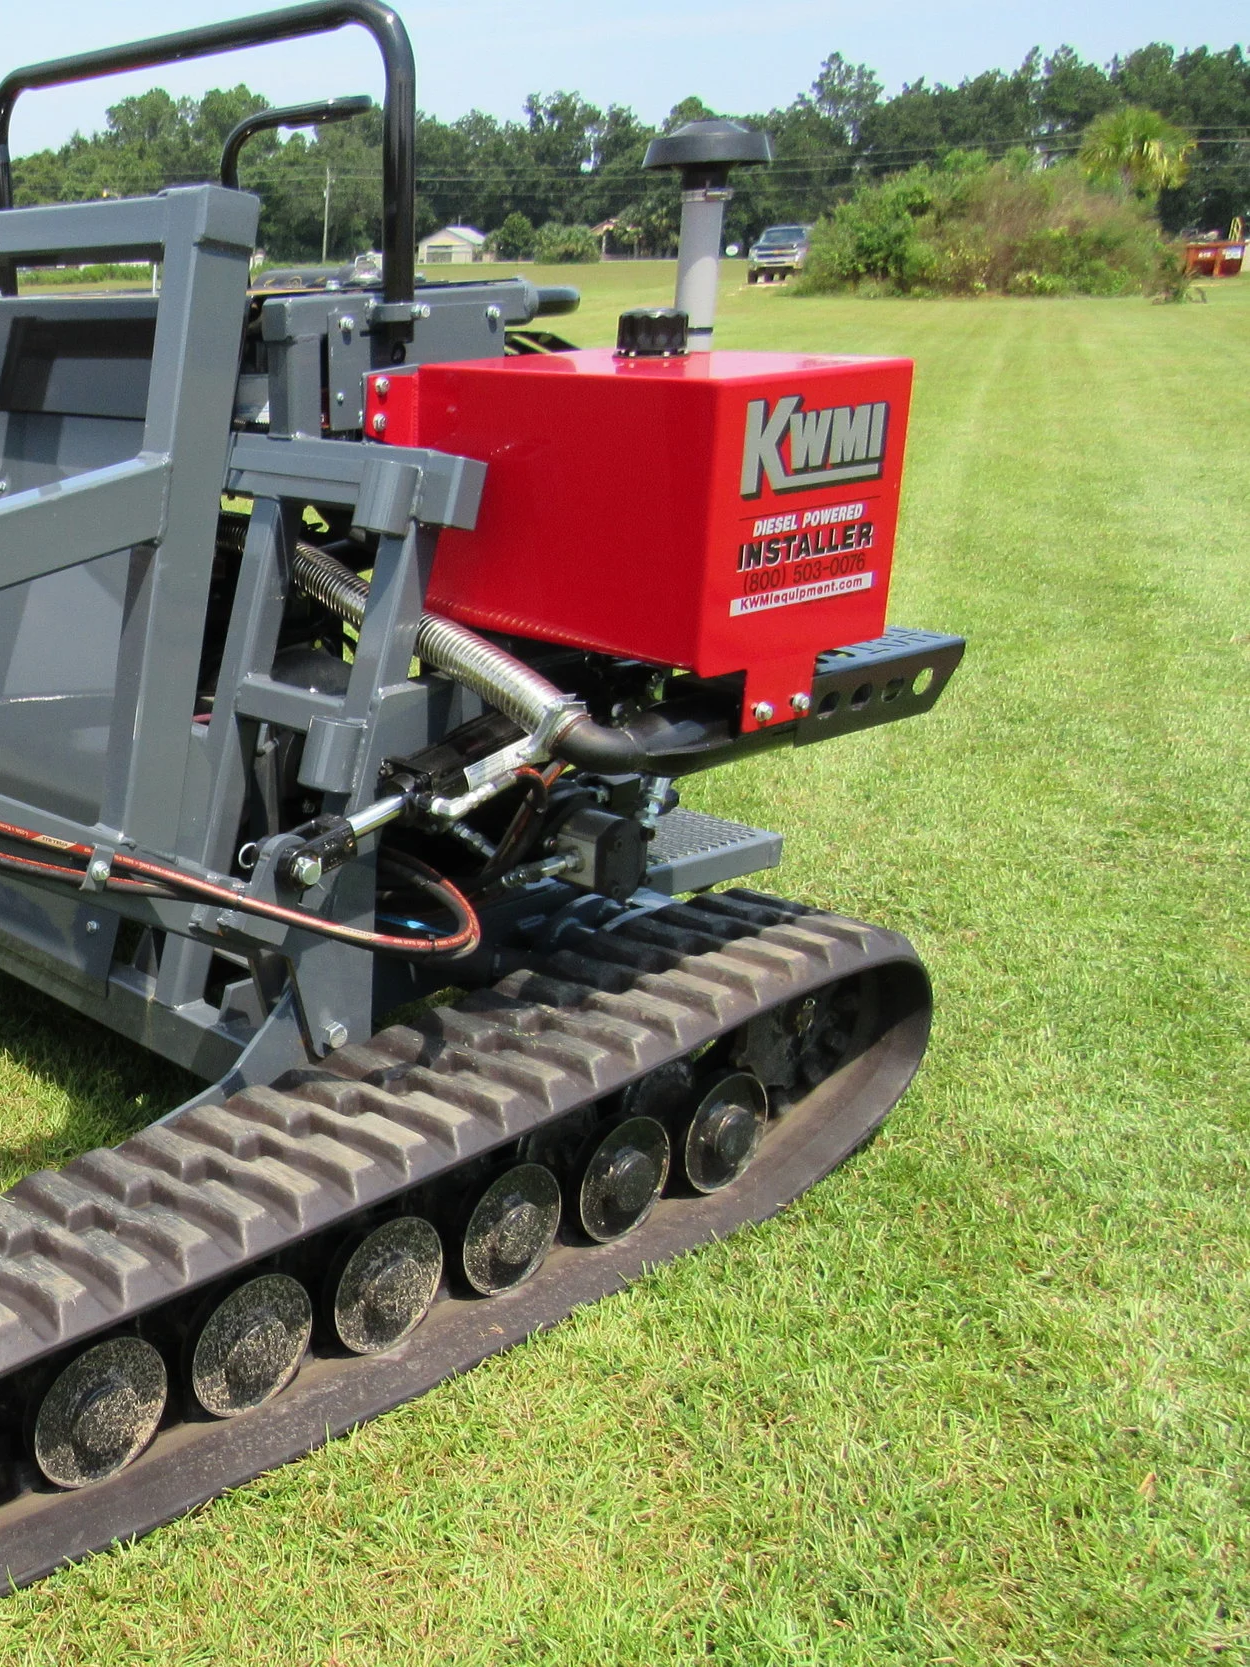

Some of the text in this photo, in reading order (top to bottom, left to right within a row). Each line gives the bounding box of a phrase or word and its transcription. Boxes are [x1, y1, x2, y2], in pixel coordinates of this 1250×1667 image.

[739, 394, 889, 500] KWMI
[753, 503, 864, 537] DIESEL POWERED
[736, 521, 874, 573] INSTALLER
[743, 552, 866, 595] (800) 503-0076
